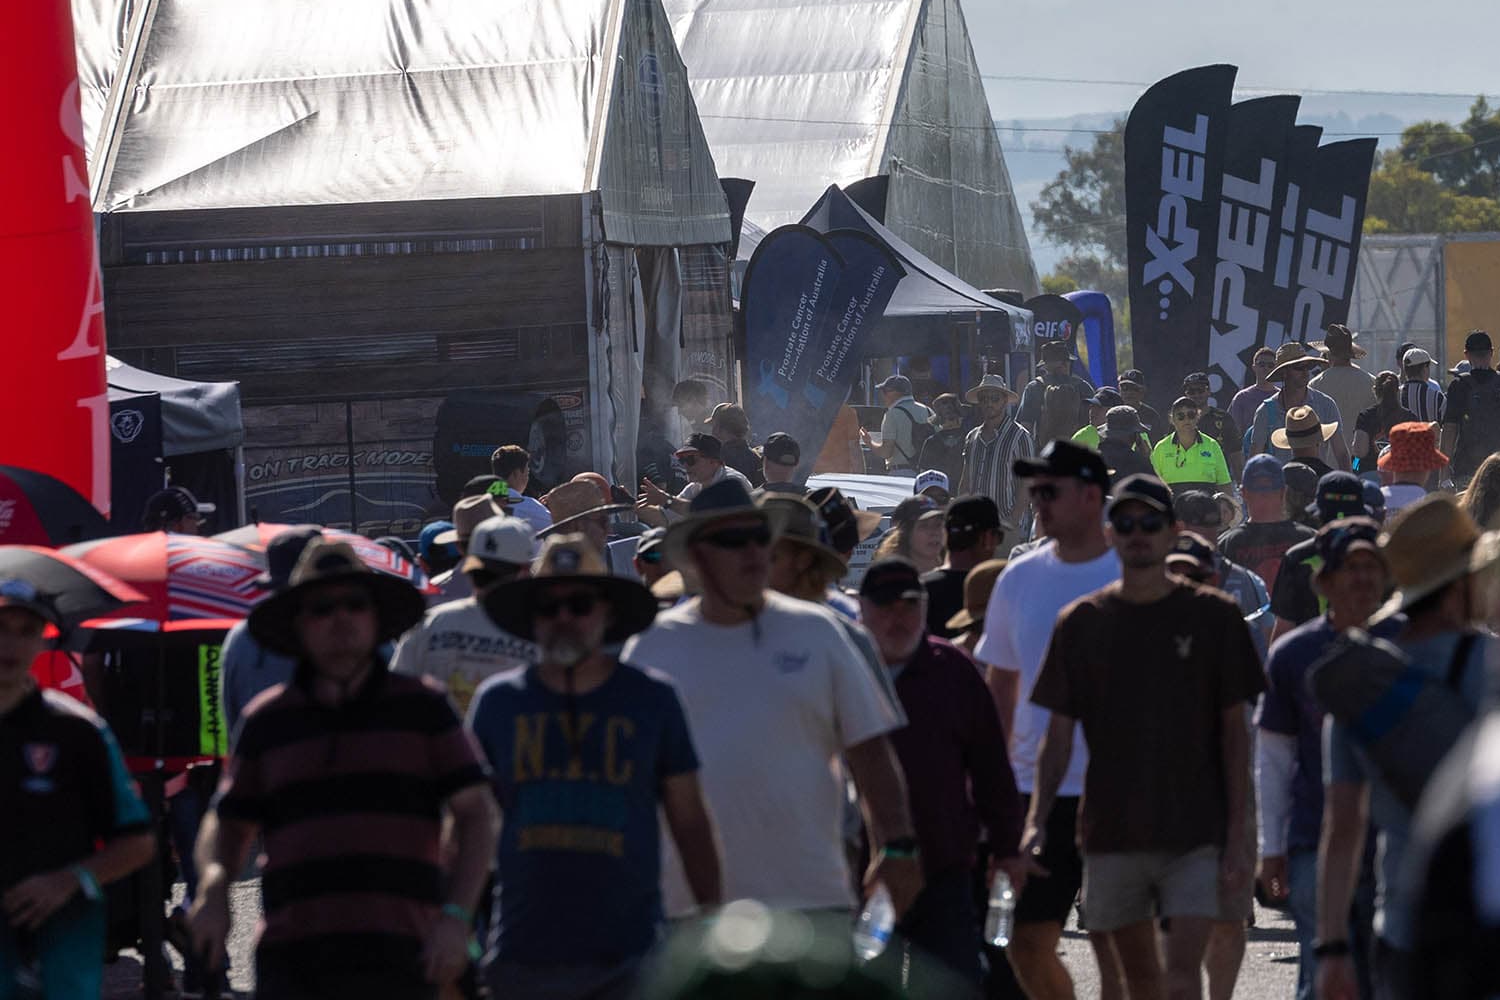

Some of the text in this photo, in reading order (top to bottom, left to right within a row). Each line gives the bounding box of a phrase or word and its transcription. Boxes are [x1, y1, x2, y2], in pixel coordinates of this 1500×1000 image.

[1143, 113, 1209, 299] XPEL
[809, 258, 828, 309] Australia
[1288, 194, 1357, 350] PEL
[778, 293, 808, 377] Prostate Cancer
[807, 307, 815, 322] of
[816, 296, 858, 377] Prostate Cancer
[826, 265, 886, 383] Foundation of Australia
[1034, 321, 1058, 338] elf
[250, 461, 281, 481] ON
[288, 451, 362, 473] TRACK
